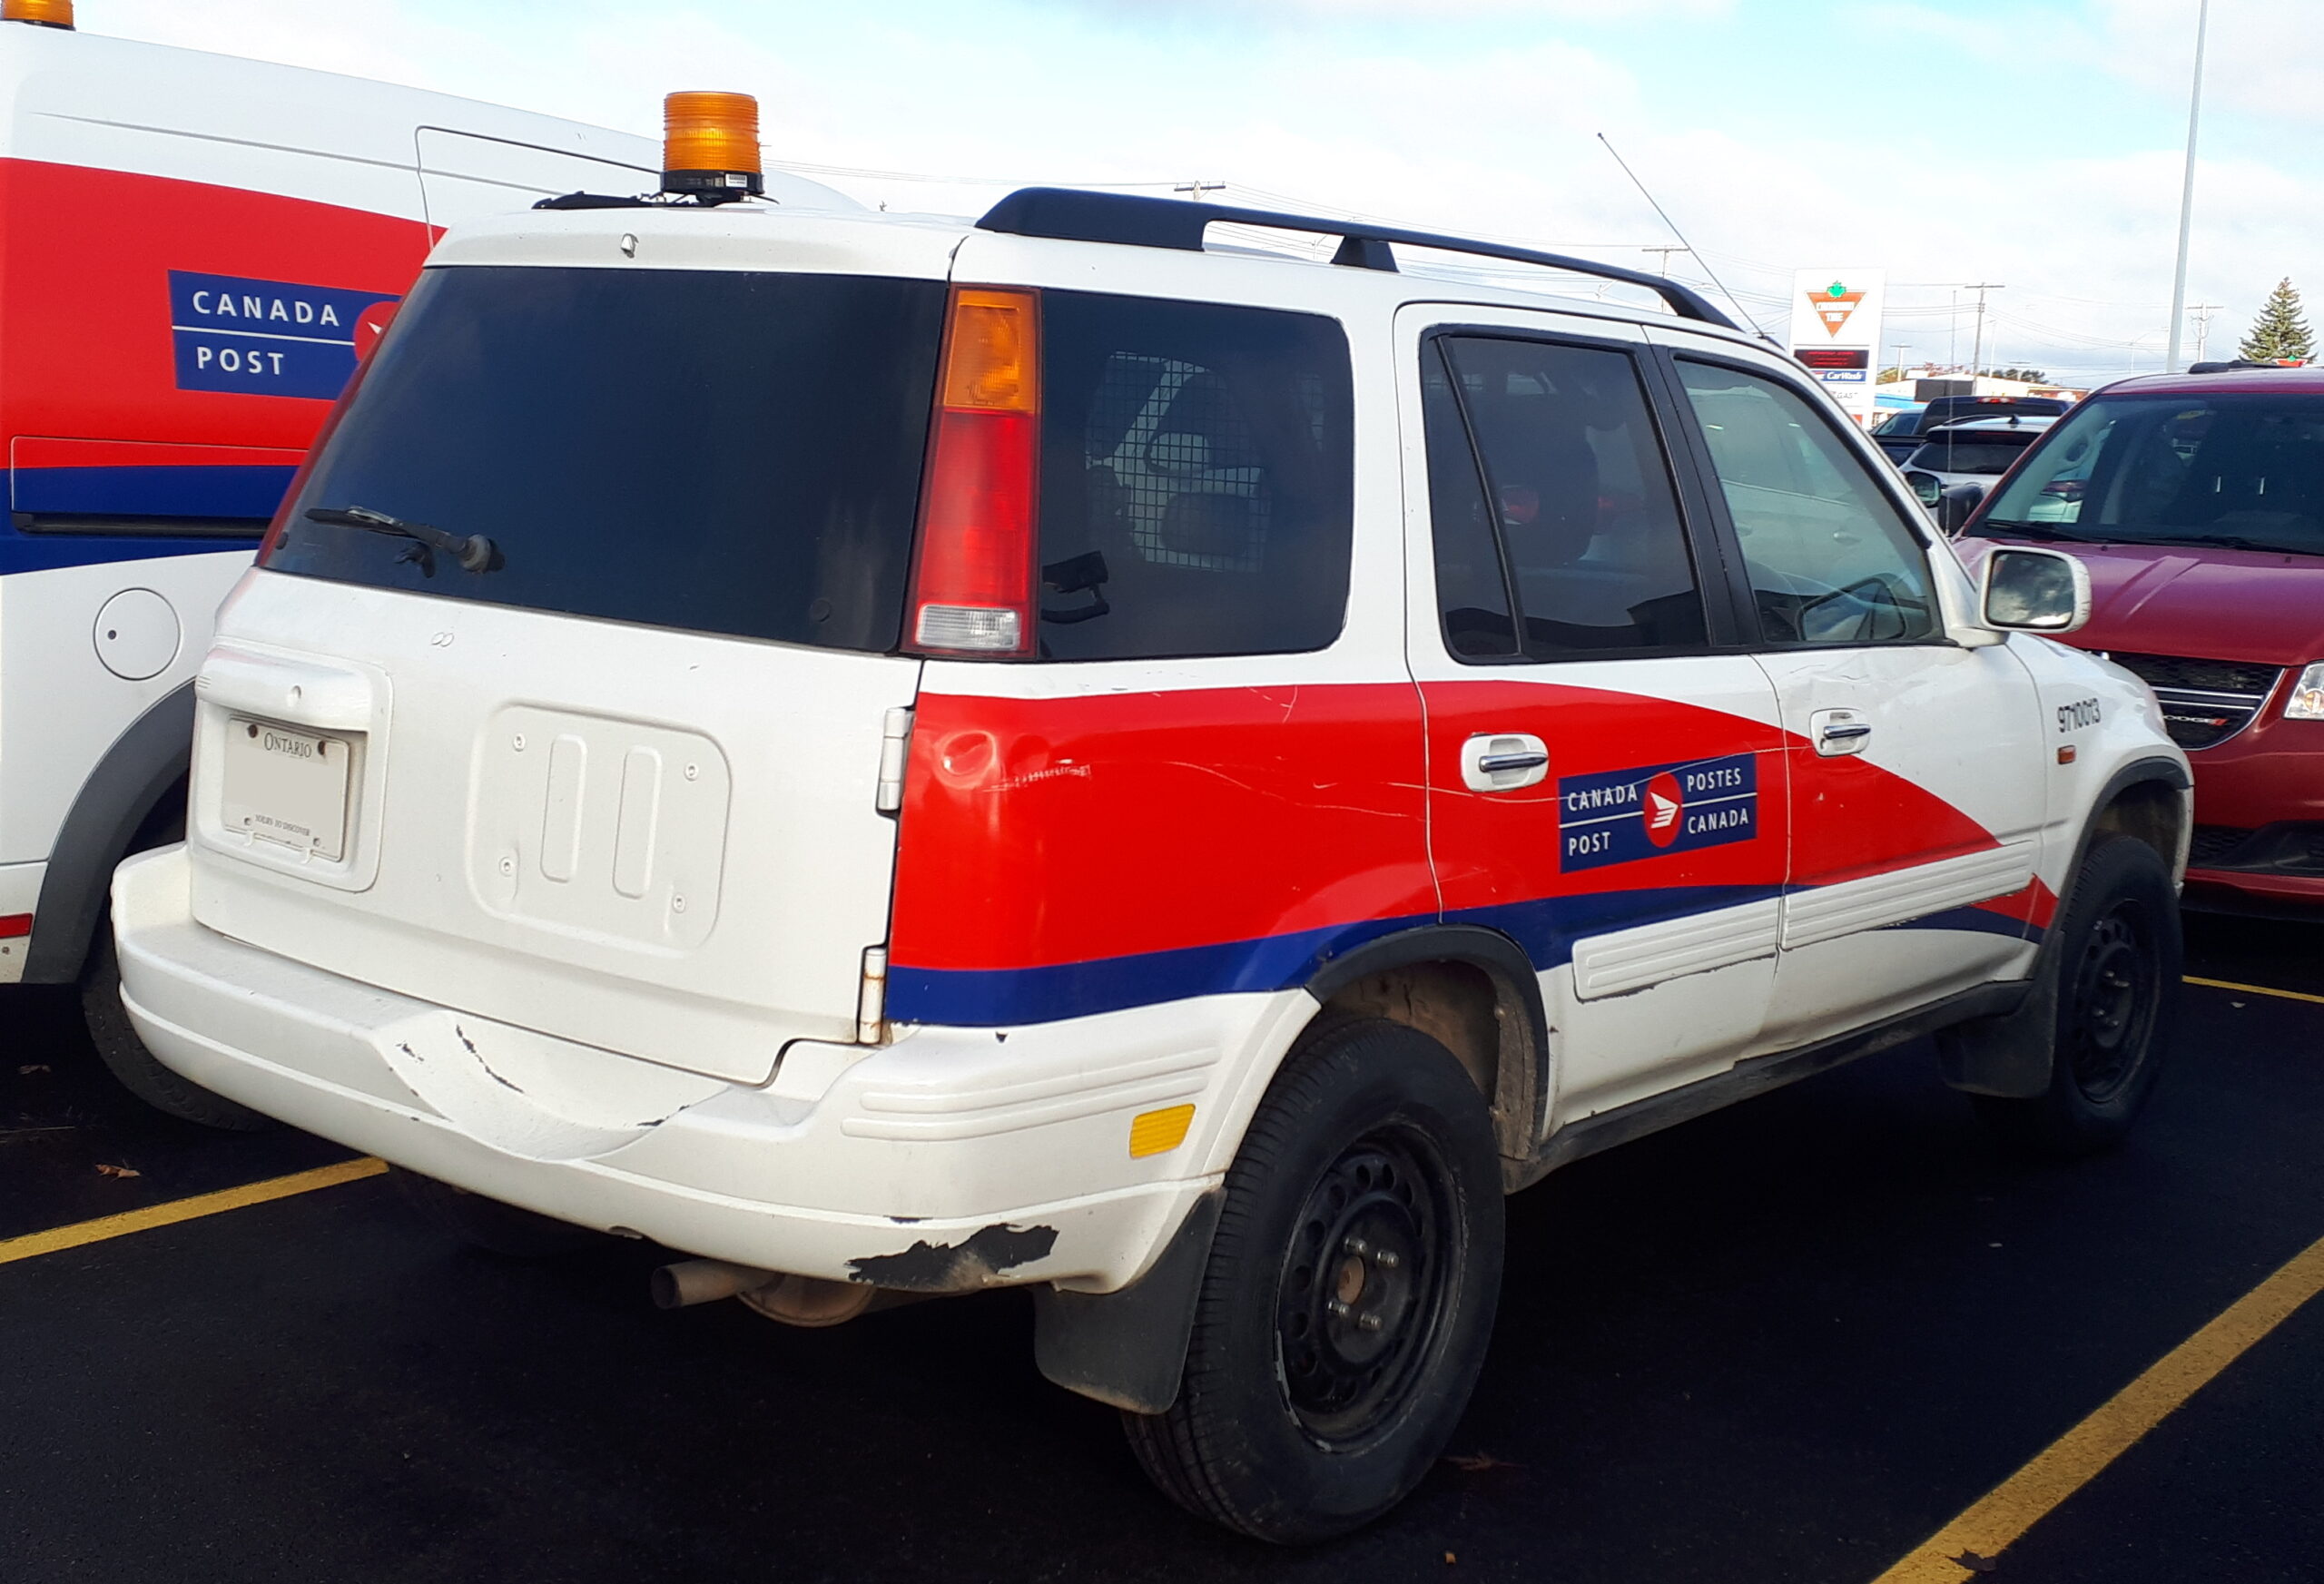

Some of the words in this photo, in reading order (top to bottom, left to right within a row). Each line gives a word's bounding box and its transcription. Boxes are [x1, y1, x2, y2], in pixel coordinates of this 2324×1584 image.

[192, 290, 340, 327] CANADA
[196, 346, 283, 375] POST
[1827, 371, 1863, 380] CarWash
[2057, 698, 2101, 733] 9710013
[2162, 714, 2216, 724] ODGE
[264, 732, 311, 758] ONTARIO
[1687, 767, 1741, 792] POSTES
[1568, 783, 1638, 812] CANADA
[1688, 808, 1748, 834] CANADA
[1569, 831, 1611, 857] POST
